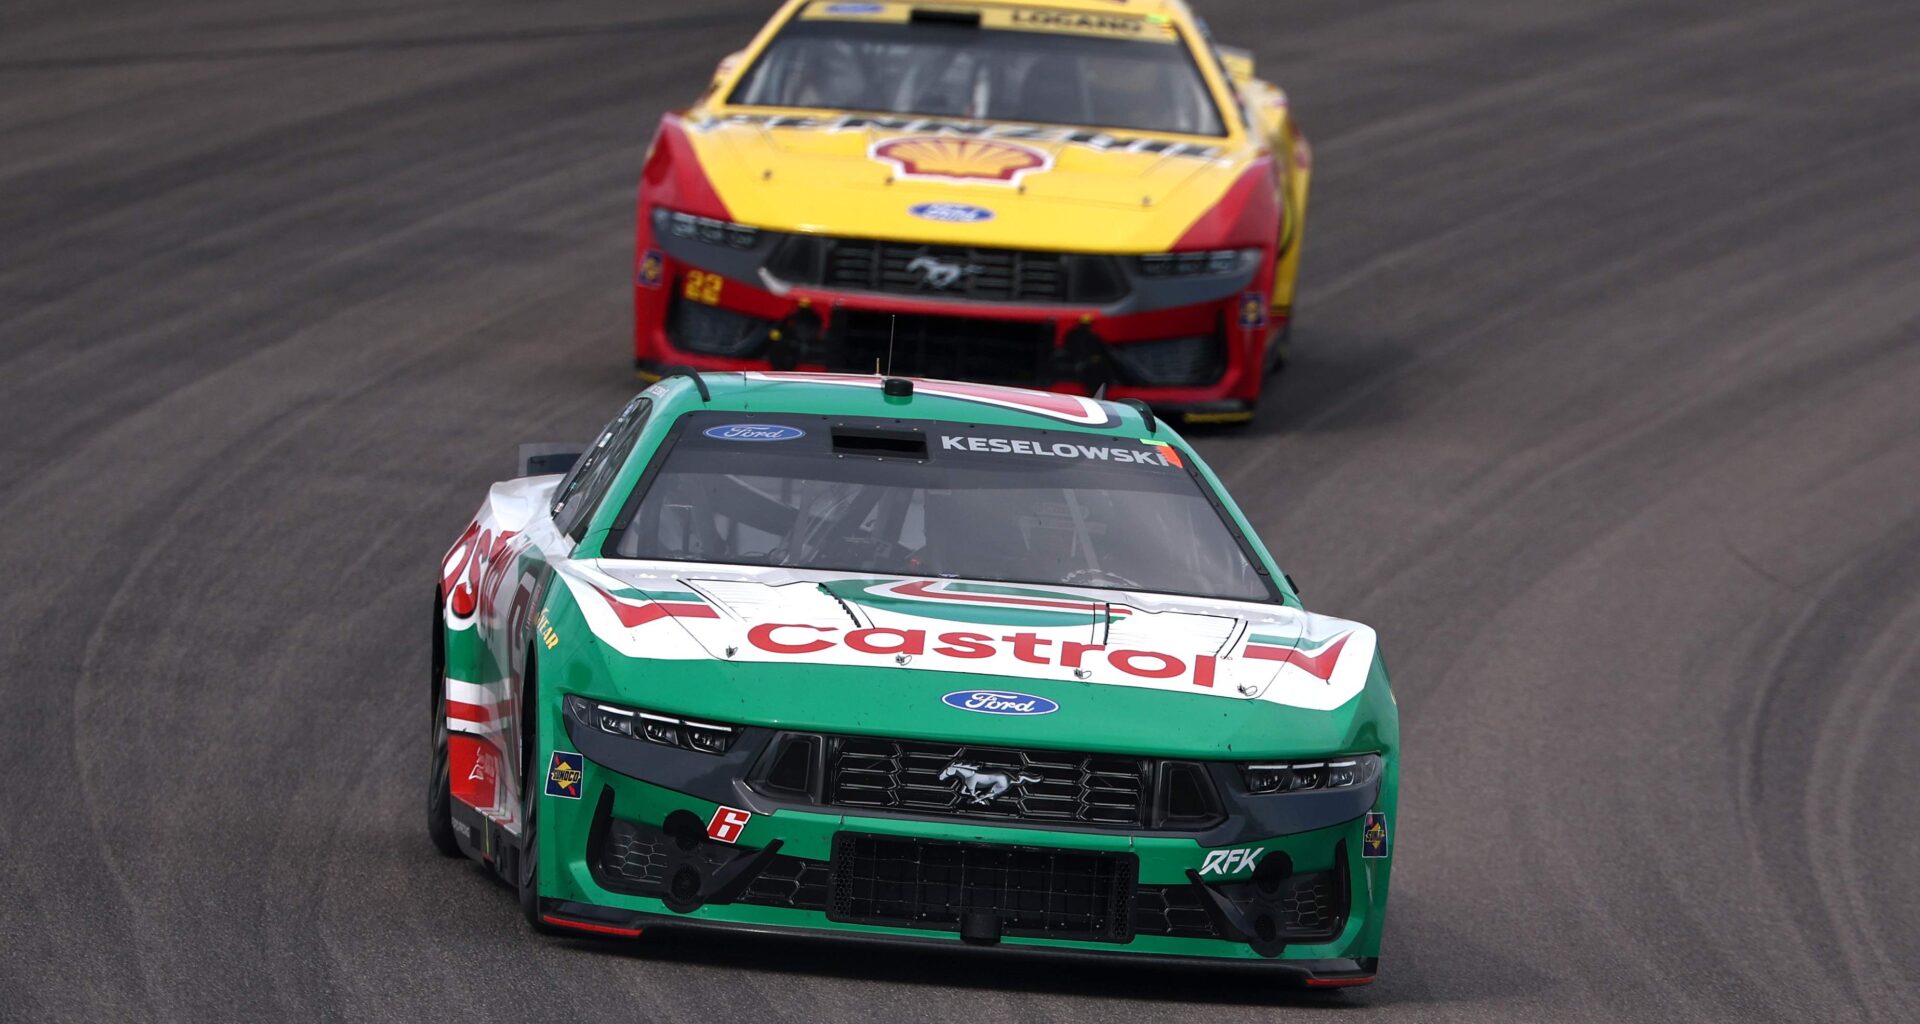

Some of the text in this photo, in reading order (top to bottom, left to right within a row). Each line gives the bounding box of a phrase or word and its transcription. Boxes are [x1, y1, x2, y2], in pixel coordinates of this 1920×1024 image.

[686, 270, 723, 304] 22
[941, 435, 1170, 467] KESELOWSKI
[747, 622, 1217, 688] Castrol
[553, 769, 580, 782] SUNOCO
[707, 806, 751, 843] 6
[1198, 847, 1264, 875] RFK
